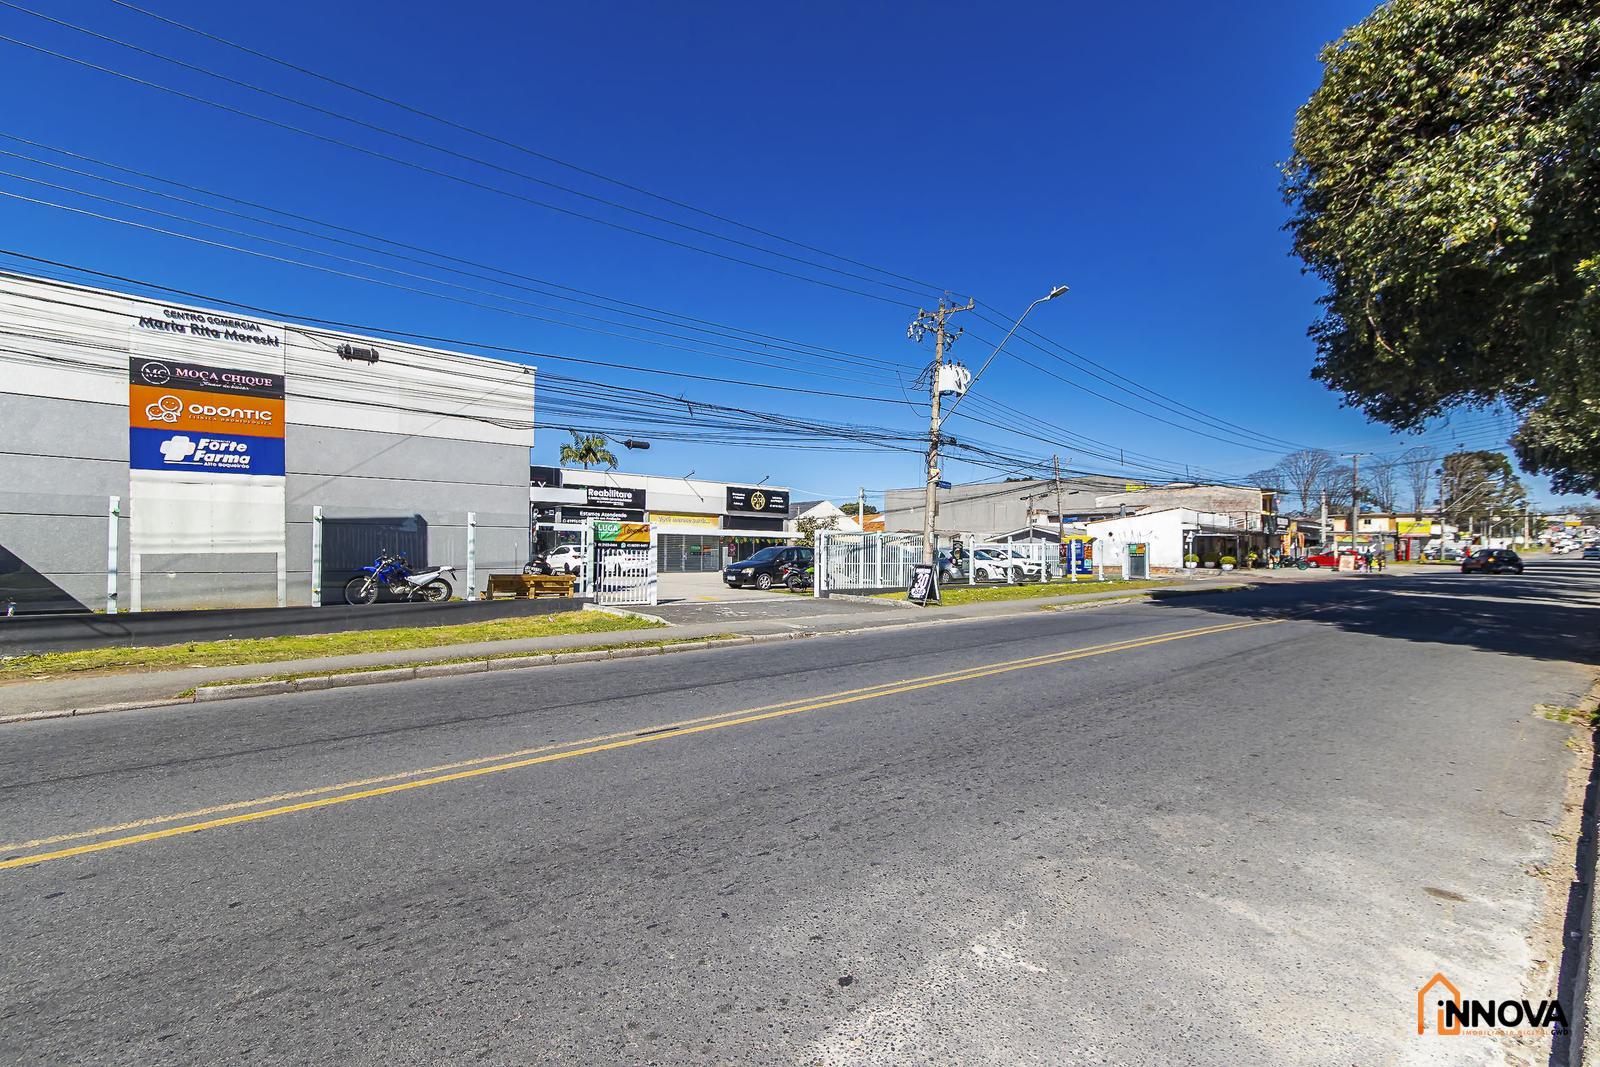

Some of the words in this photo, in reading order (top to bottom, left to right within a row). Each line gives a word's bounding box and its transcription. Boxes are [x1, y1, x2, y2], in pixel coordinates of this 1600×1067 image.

[139, 316, 186, 334] Maria
[190, 322, 221, 339] Rita
[163, 309, 206, 323] CENTRO
[207, 316, 263, 332] COMERCIAL
[175, 368, 219, 382] MOÇA
[221, 373, 273, 387] CHIQUE
[188, 404, 273, 421] ODONTIC
[197, 438, 248, 452] Forte
[193, 450, 251, 464] Farma
[588, 488, 633, 499] Reabilitare
